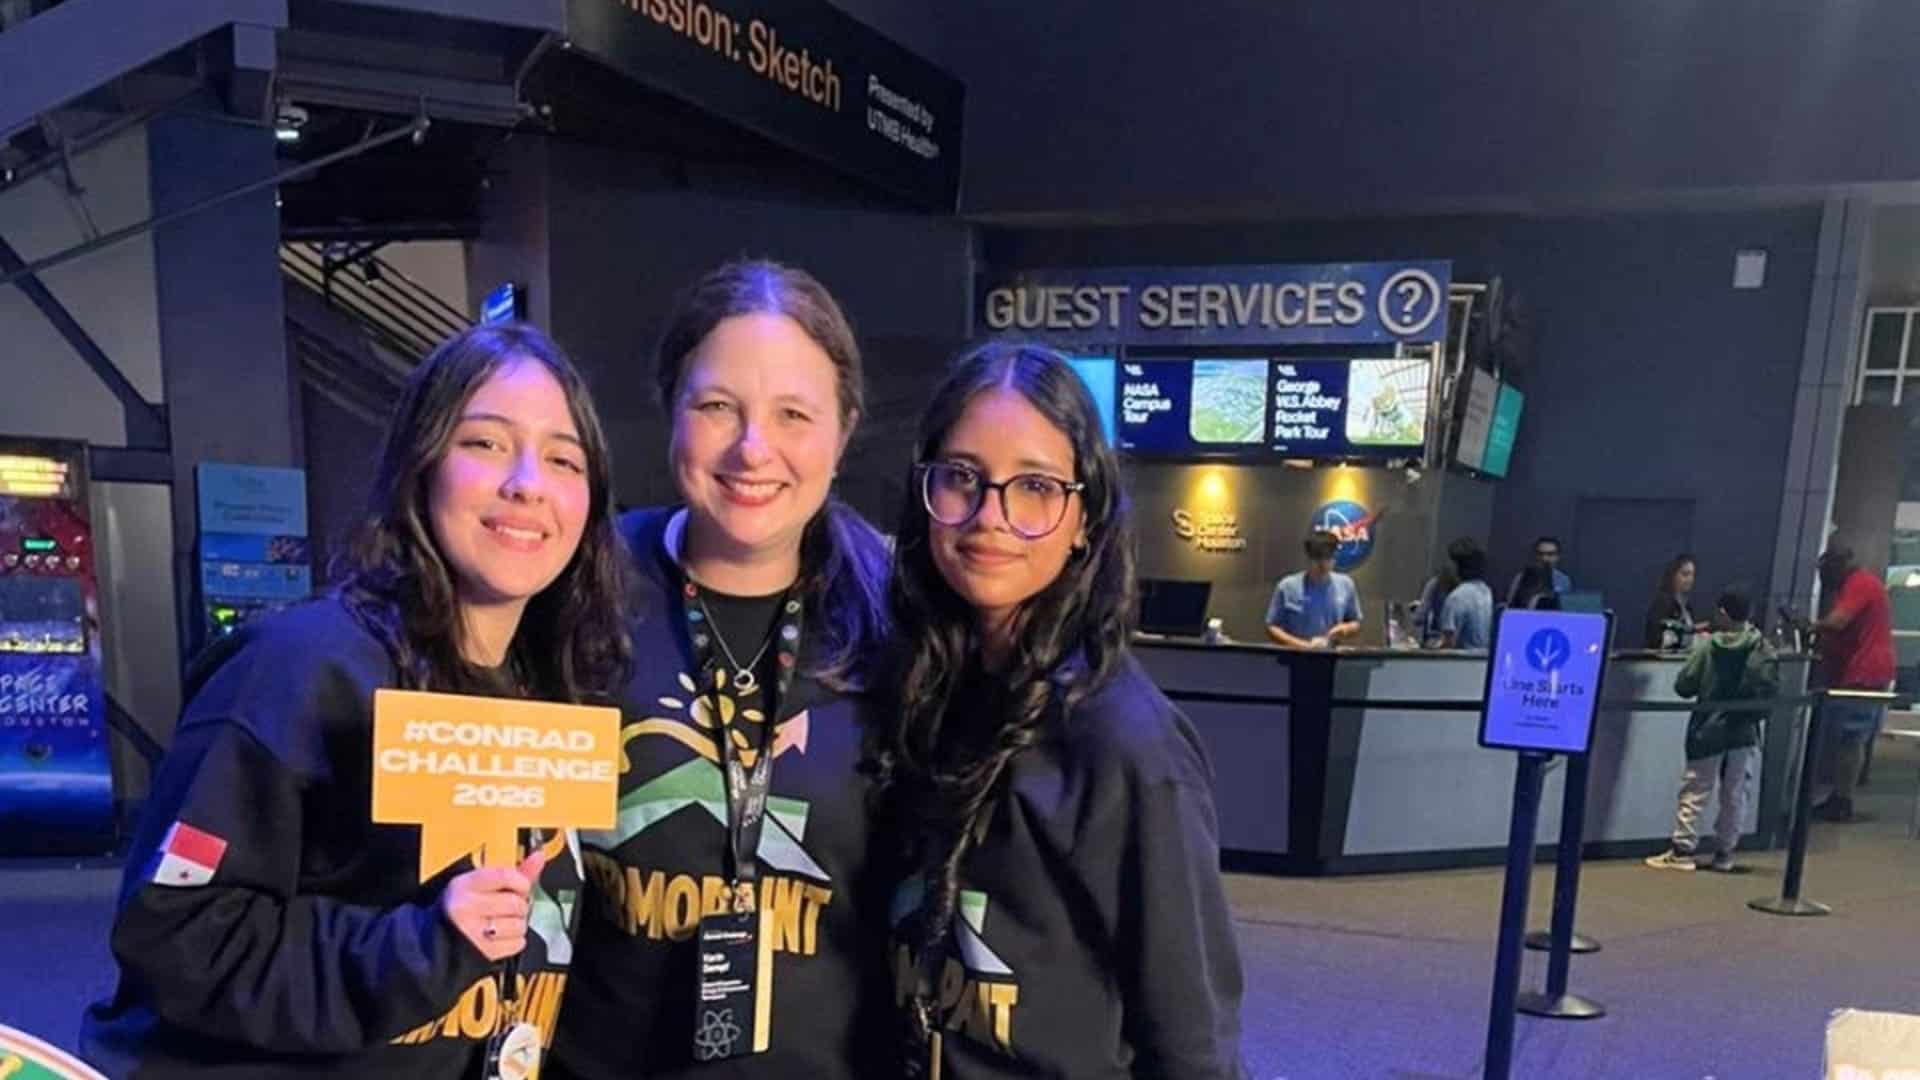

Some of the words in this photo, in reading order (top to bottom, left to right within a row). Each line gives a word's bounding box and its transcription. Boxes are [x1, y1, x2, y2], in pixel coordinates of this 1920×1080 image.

[617, 0, 742, 62] ssion:
[748, 21, 842, 112] Sketch
[868, 74, 919, 121] Presented
[921, 104, 934, 133] by
[983, 285, 1129, 329] GUEST
[1139, 281, 1365, 329] SERVICES
[1123, 382, 1159, 396] NASA
[1276, 380, 1321, 395] George
[1123, 397, 1171, 412] Campus
[1123, 408, 1149, 423] Tour
[1275, 410, 1317, 425] Rocket
[1275, 425, 1301, 439] Park
[1302, 426, 1330, 440] Tour
[1521, 693, 1561, 709] Here
[402, 719, 597, 752] #CONRAD
[379, 746, 615, 783] CHALLENGE
[451, 783, 545, 808] 2026
